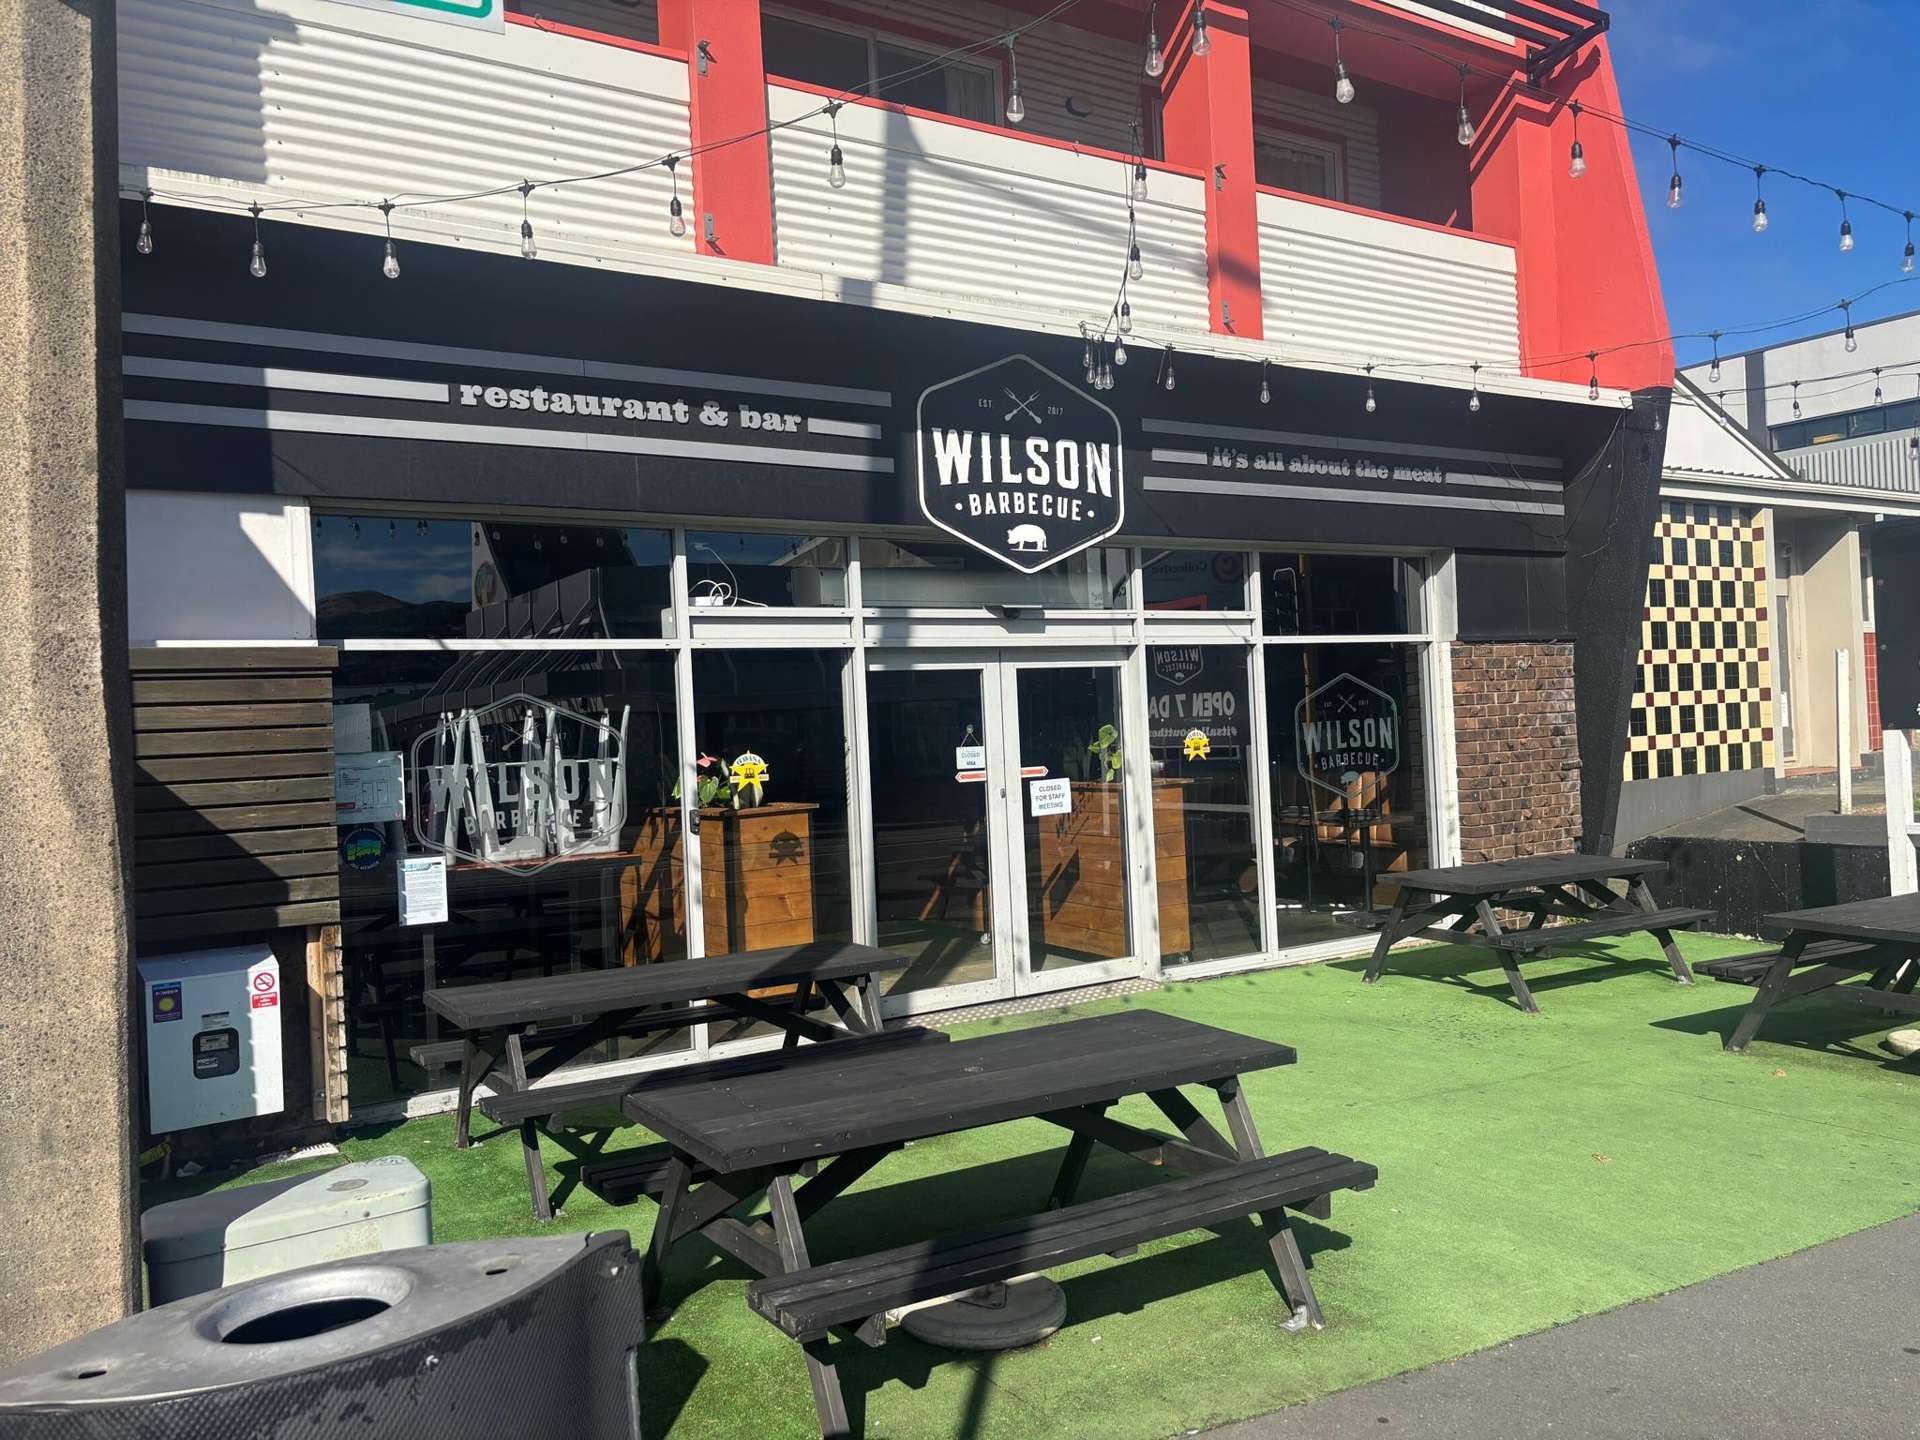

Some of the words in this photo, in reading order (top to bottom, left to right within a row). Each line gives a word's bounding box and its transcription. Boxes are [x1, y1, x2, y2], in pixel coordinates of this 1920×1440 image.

[460, 384, 689, 424] restaurant
[699, 401, 729, 427] &
[739, 404, 801, 433] bar
[931, 427, 1113, 498] WILSON
[1212, 446, 1249, 469] it's
[1253, 451, 1285, 471] all
[1288, 454, 1351, 476] about
[1355, 459, 1389, 480] the
[1392, 465, 1442, 484] meat
[968, 491, 1082, 521] BARBECUE
[1302, 717, 1394, 756] WILSON
[1321, 751, 1380, 771] BARBECUE
[427, 758, 615, 813] WILSON
[1035, 794, 1048, 802] FOR
[1048, 792, 1066, 800] STAFF
[1038, 784, 1062, 793] CLOSED
[1038, 800, 1064, 810] MEETING
